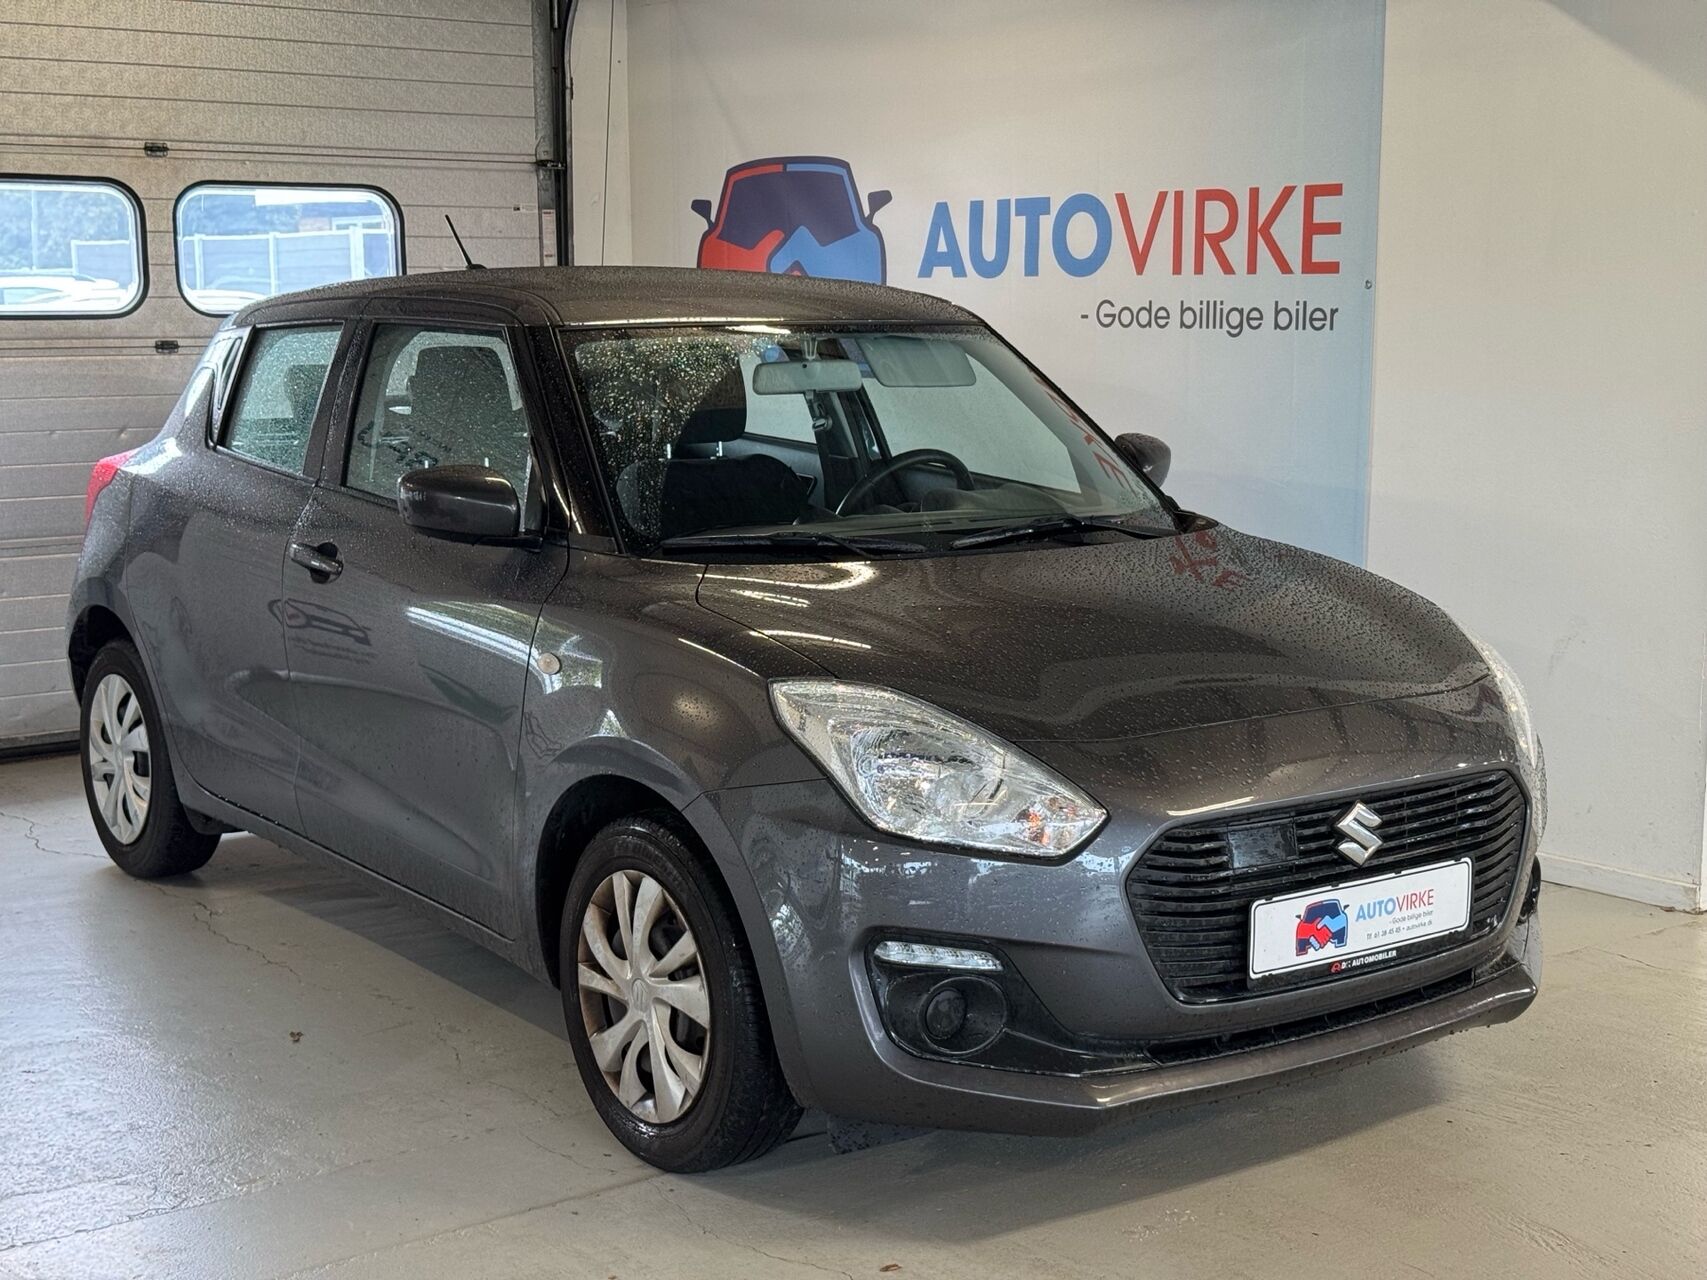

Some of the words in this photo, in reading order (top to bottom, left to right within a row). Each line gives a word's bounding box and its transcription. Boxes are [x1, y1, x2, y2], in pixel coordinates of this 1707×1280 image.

[917, 183, 1344, 279] AUTOVIRKE
[1095, 299, 1171, 329] Gode
[1179, 300, 1264, 337] billige
[1273, 300, 1339, 331] biler
[1355, 889, 1434, 922] AUTOVIRKE
[1352, 950, 1397, 967] AUTOMOBILER
